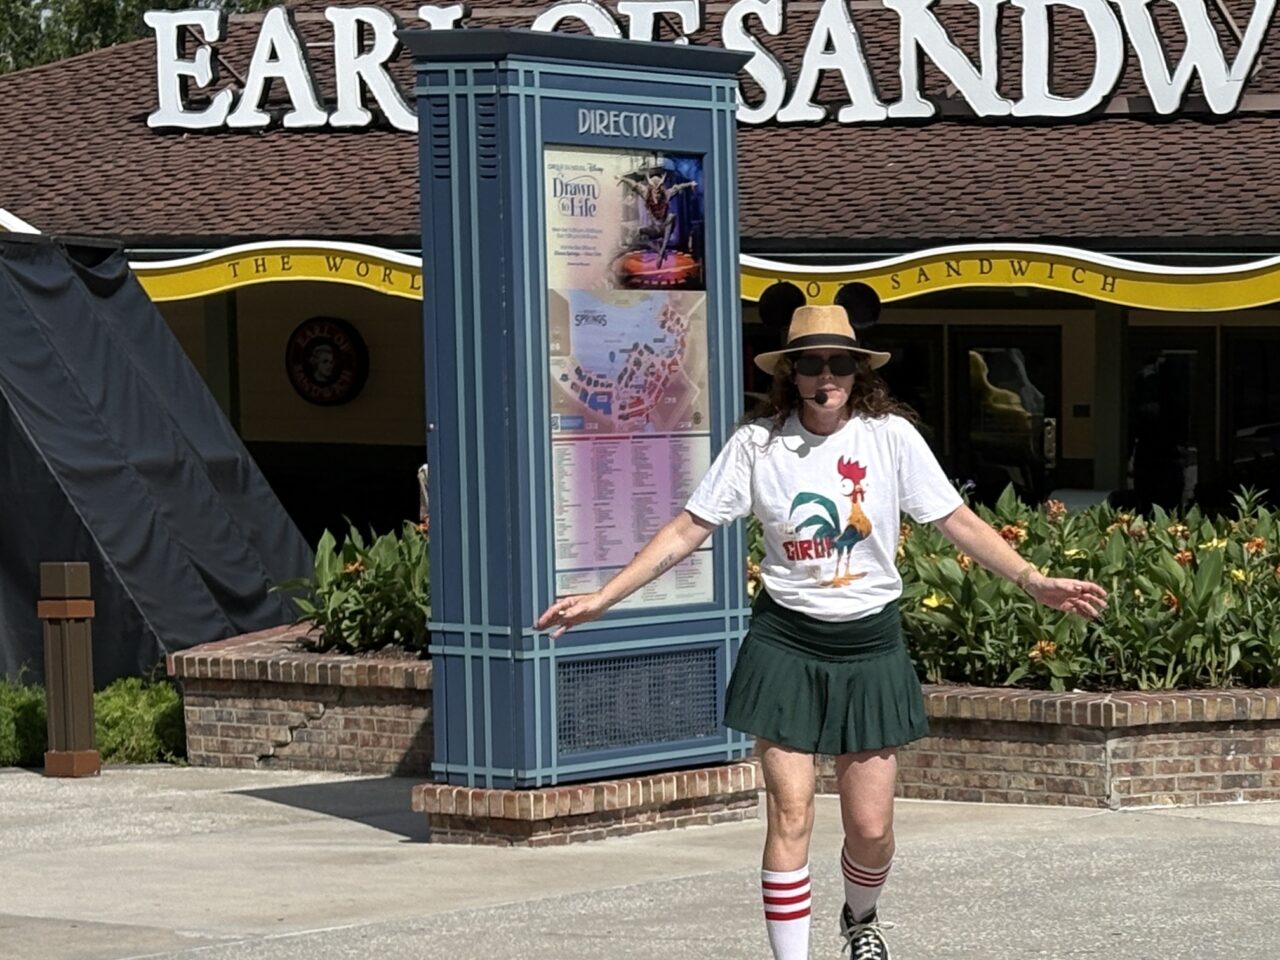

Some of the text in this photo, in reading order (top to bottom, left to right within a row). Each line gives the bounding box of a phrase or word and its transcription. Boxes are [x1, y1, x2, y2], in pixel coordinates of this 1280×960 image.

[145, 6, 464, 132] EAR
[577, 108, 676, 140] DIRECTORY
[553, 177, 600, 200] Drawn
[570, 197, 597, 218] Life
[228, 255, 422, 291] THE WORL
[891, 258, 1117, 293] SANDWICH
